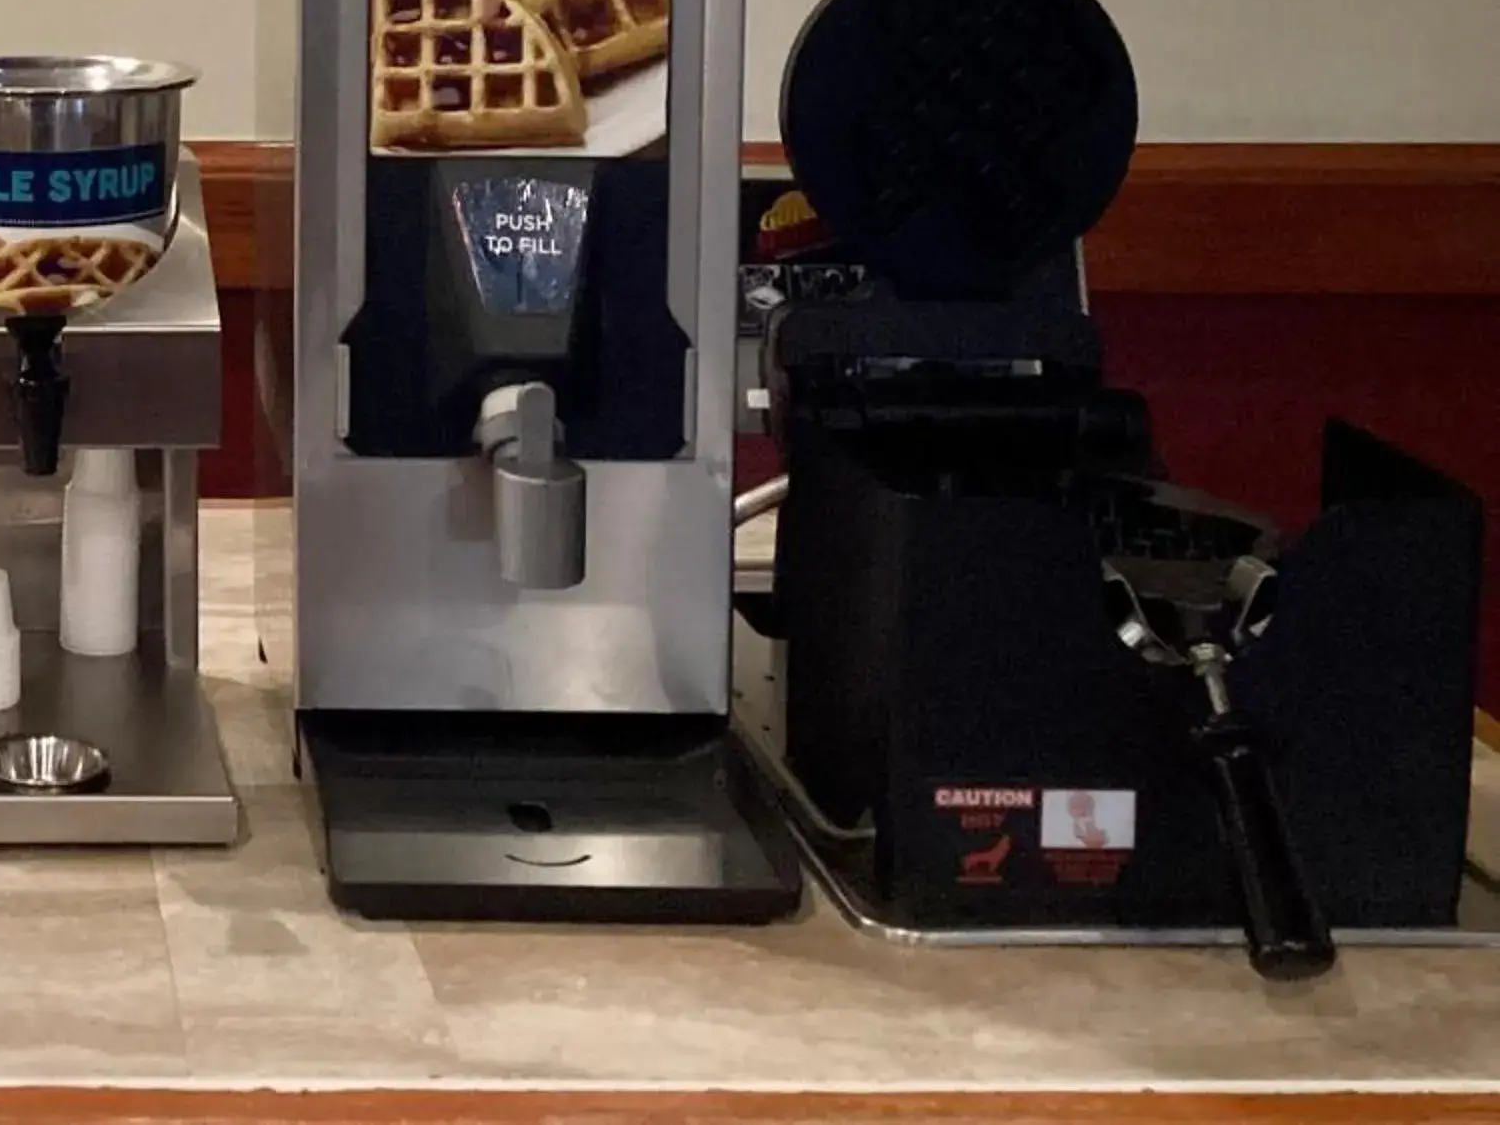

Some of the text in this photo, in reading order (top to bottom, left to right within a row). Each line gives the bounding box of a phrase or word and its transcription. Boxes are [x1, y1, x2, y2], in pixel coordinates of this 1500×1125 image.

[49, 161, 156, 203] SYRUP
[495, 213, 550, 232] PUSH
[485, 235, 562, 256] TO FILL
[935, 788, 1033, 808] CAUTION
